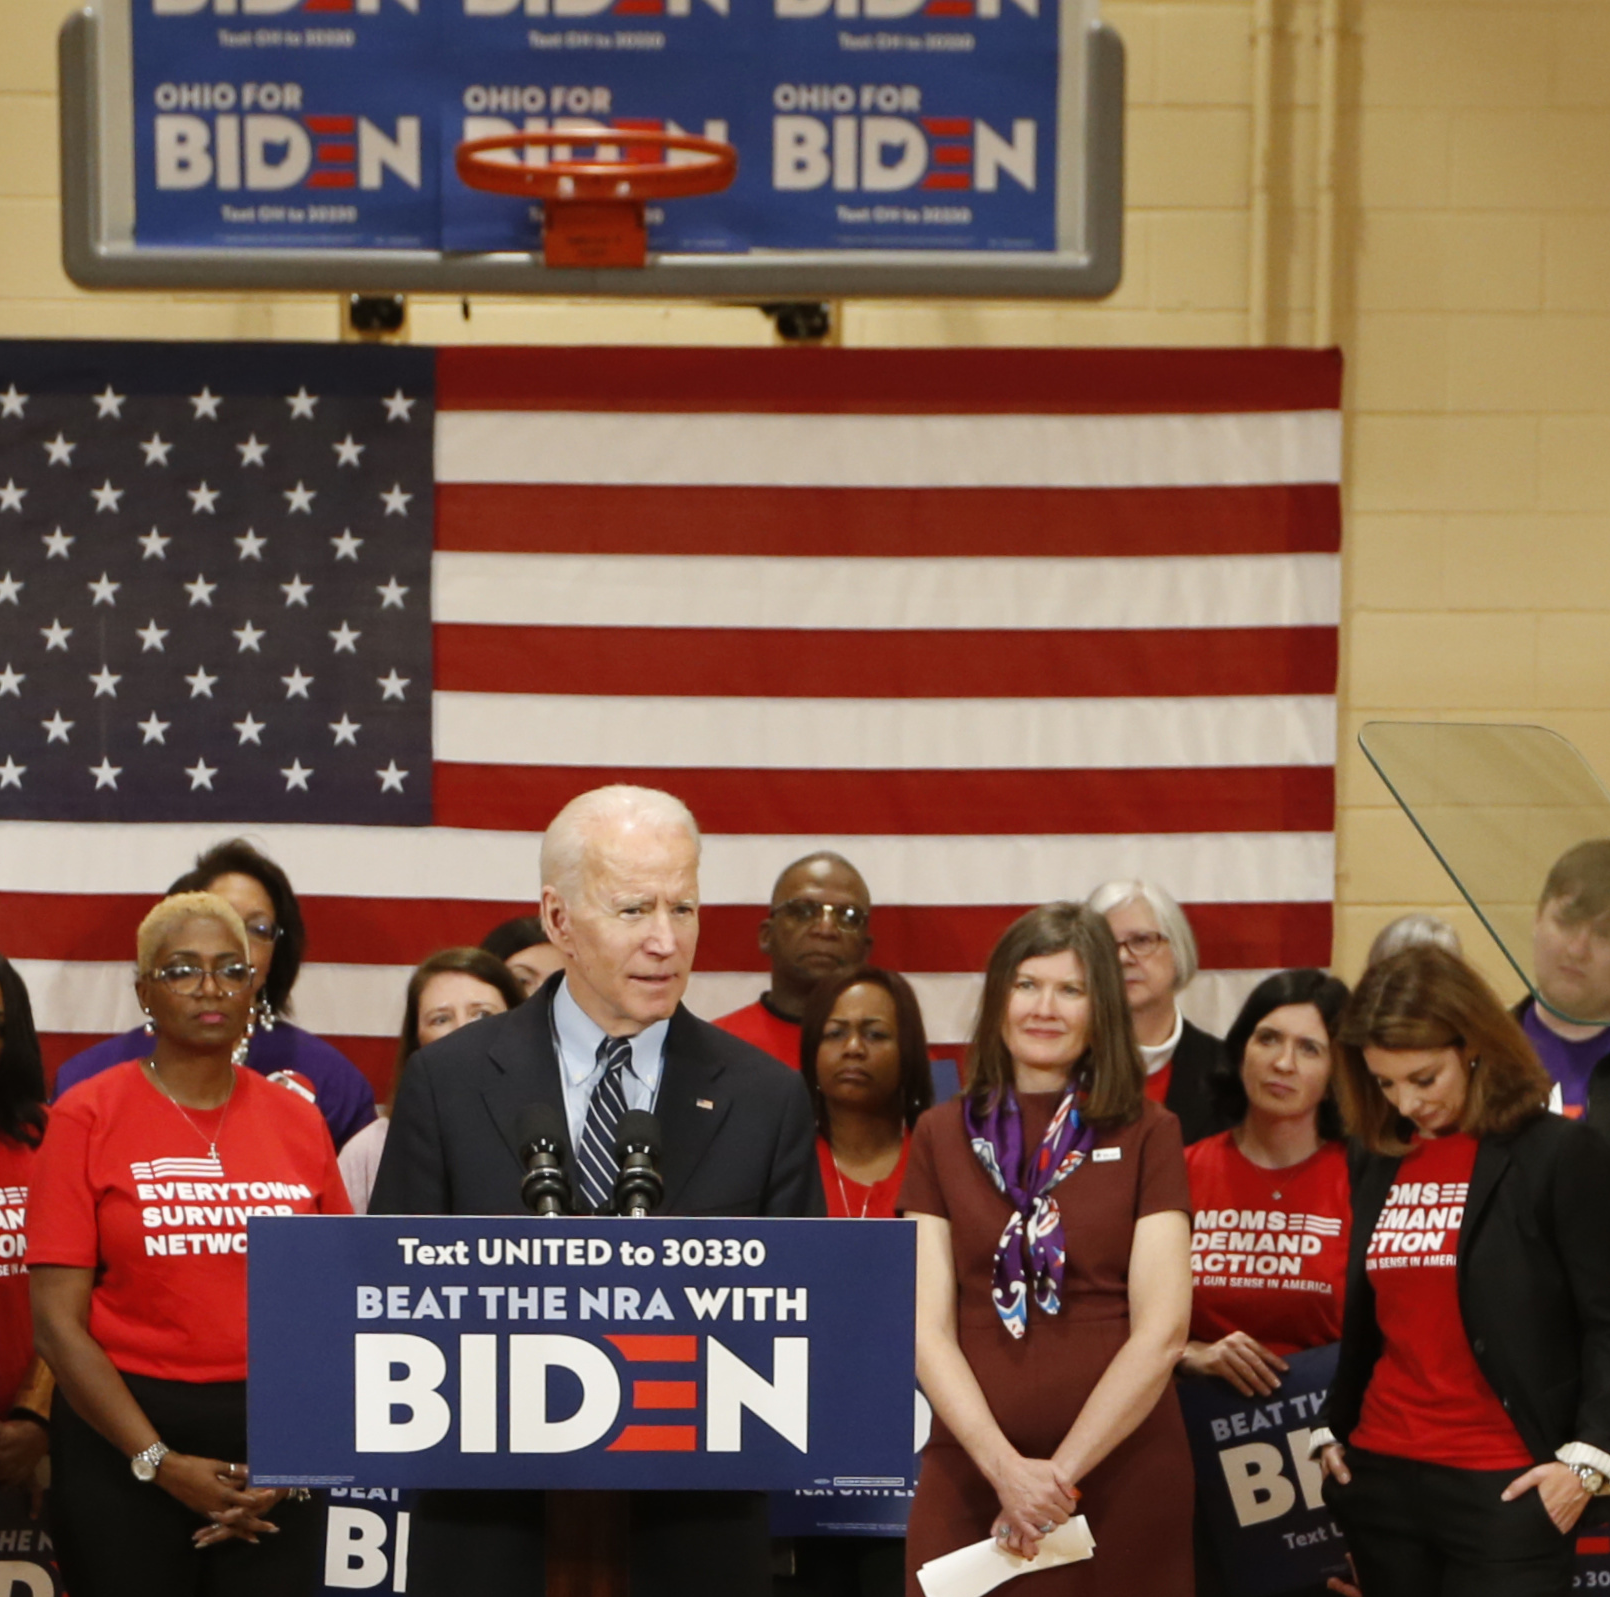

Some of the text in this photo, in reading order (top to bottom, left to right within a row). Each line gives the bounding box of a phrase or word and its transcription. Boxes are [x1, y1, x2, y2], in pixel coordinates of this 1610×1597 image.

[154, 82, 303, 111] OHIO FOR
[463, 85, 612, 113] OHIO FOR
[773, 84, 922, 112] OHIO FOR
[155, 114, 421, 191] BIDEN
[773, 115, 1037, 192] BIDEN
[137, 1181, 312, 1201] EVERYTOWN
[1385, 1182, 1440, 1206] OMS
[1194, 1208, 1287, 1231] MOMS
[144, 1233, 247, 1257] NETWO
[397, 1238, 766, 1267] Text UNITED to 30330
[1190, 1231, 1322, 1255] DEMAND
[1190, 1253, 1302, 1275] ACTION
[1379, 1256, 1408, 1269] SENSE
[1423, 1254, 1457, 1266] AMERI
[1203, 1275, 1227, 1287] GUN
[1229, 1276, 1265, 1289] SENSE
[1267, 1278, 1280, 1289] IN
[1281, 1279, 1333, 1294] AMERICA
[356, 1286, 808, 1321] BEAT THE NRA WITH
[354, 1333, 808, 1453] BIDEN
[1210, 1390, 1327, 1443] BEAT TH
[1282, 1526, 1328, 1549] Text
